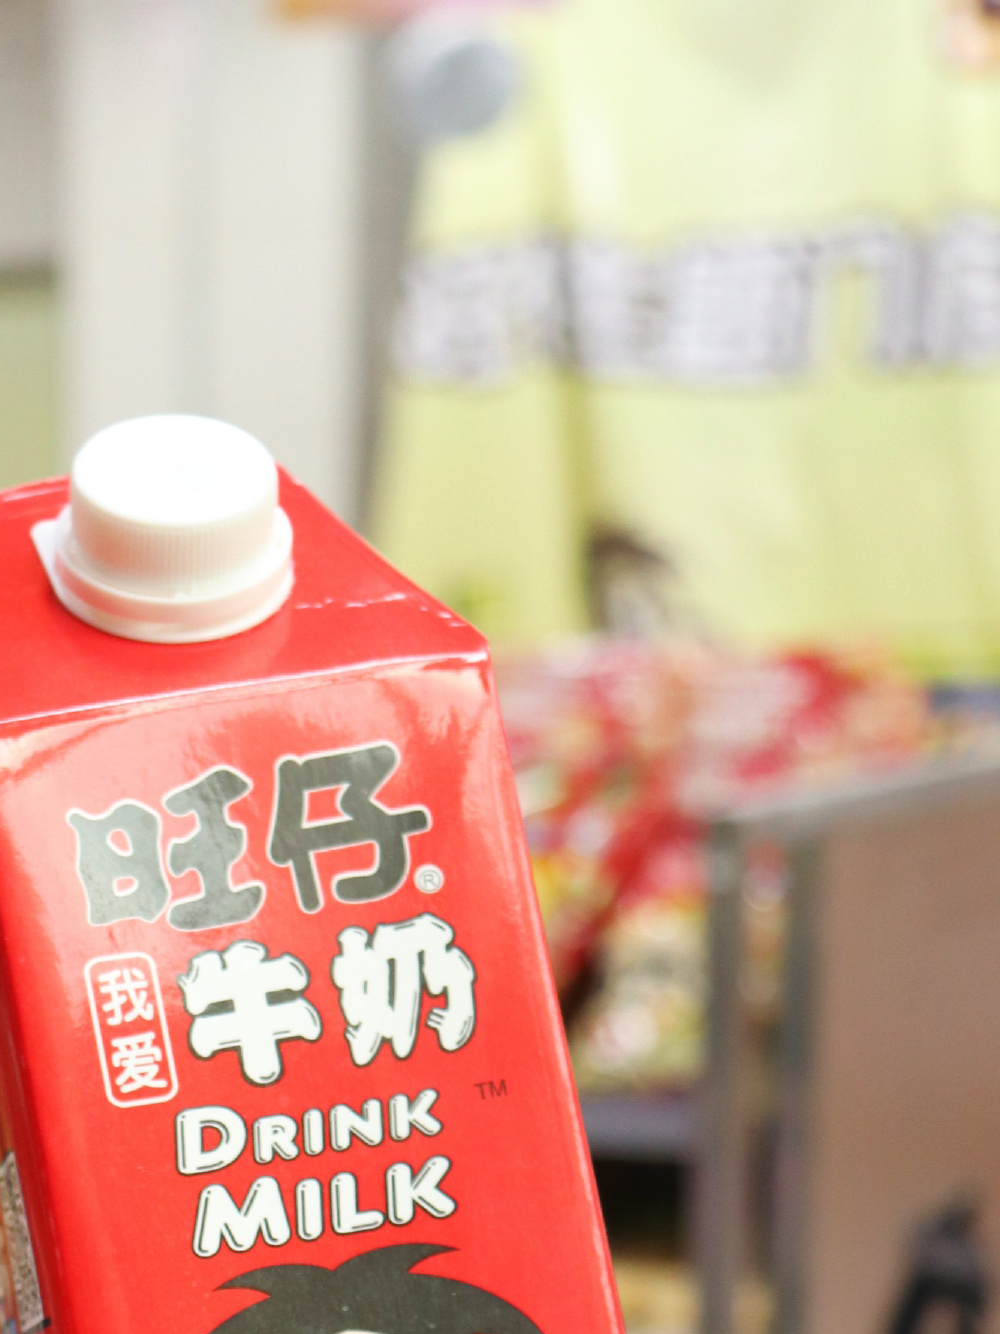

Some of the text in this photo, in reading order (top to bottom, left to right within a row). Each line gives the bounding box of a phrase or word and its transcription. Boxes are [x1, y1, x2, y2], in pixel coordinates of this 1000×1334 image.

[67, 742, 432, 932] 旺仔
[97, 966, 168, 1095] 我爱
[177, 913, 477, 1085] 牛奶
[174, 1088, 442, 1175] DRINK
[192, 1155, 456, 1258] MILK
